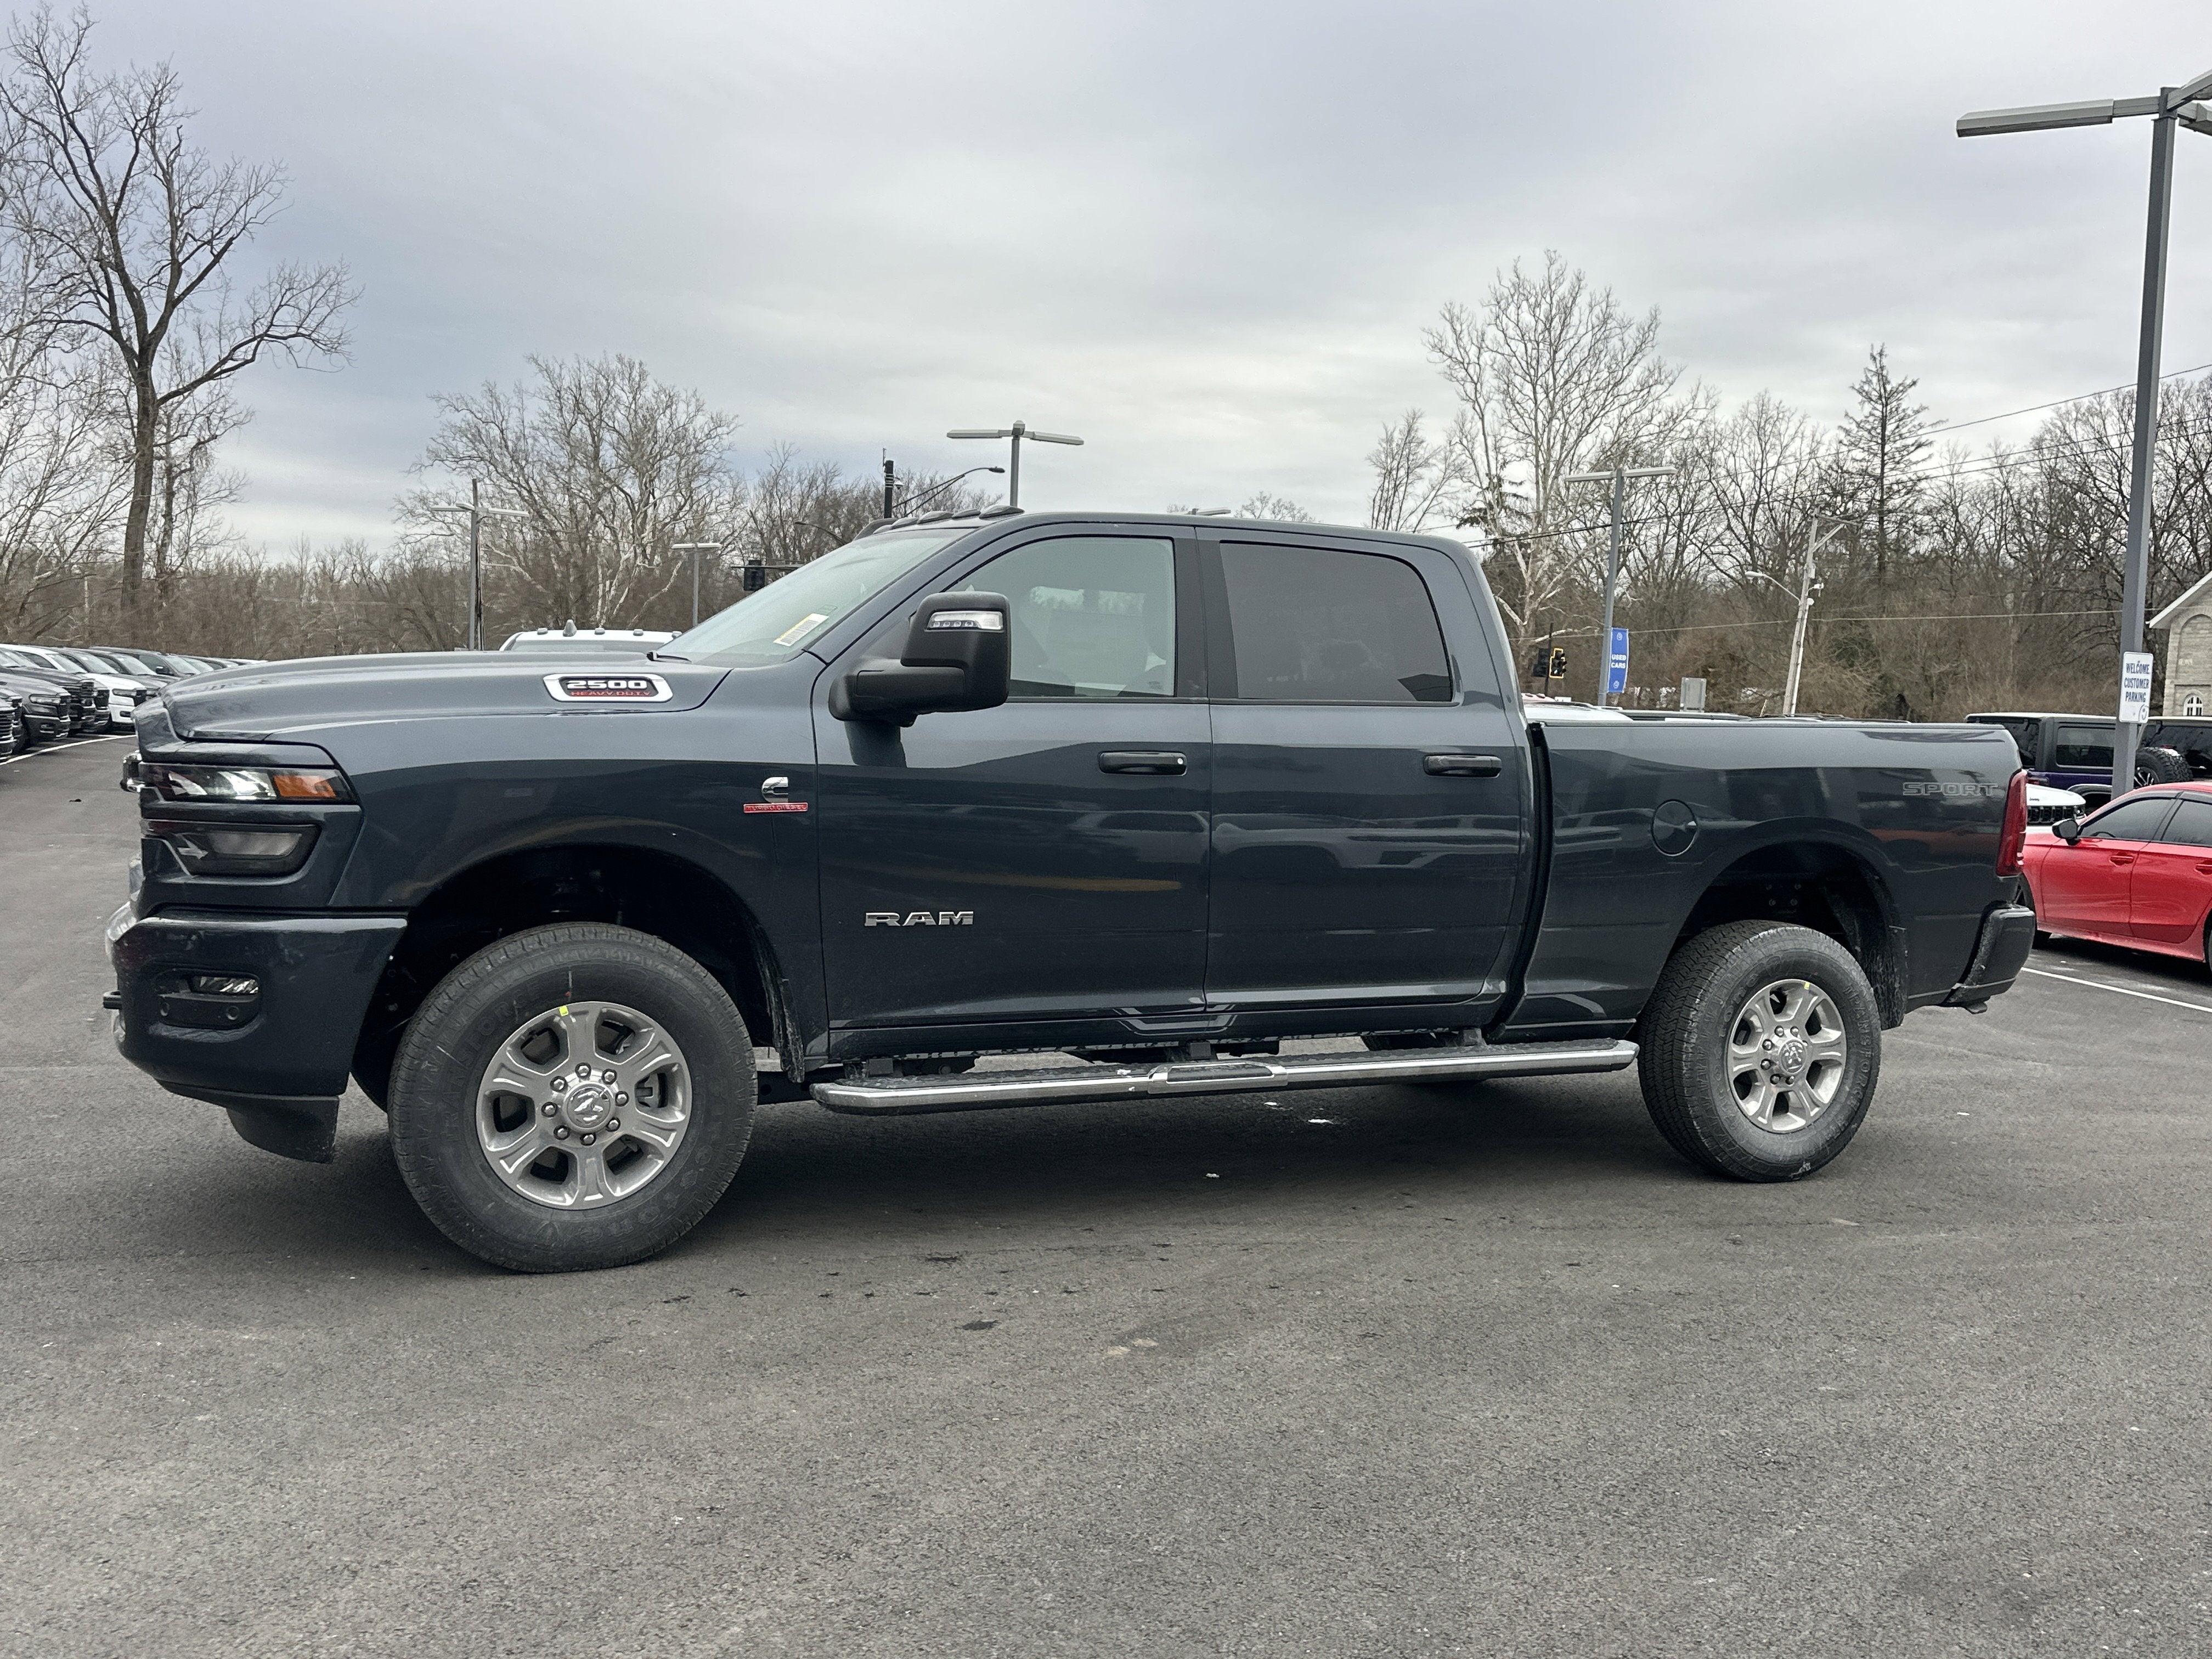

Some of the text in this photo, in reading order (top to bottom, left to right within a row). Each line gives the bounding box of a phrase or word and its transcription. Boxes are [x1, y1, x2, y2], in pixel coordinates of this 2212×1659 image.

[2126, 663, 2150, 674] WELCOME
[567, 680, 647, 690] 2500
[2124, 677, 2149, 689] CUSTOMER
[2125, 691, 2147, 703] PARKING
[1902, 782, 1999, 796] SPORT
[864, 911, 974, 927] RAM
